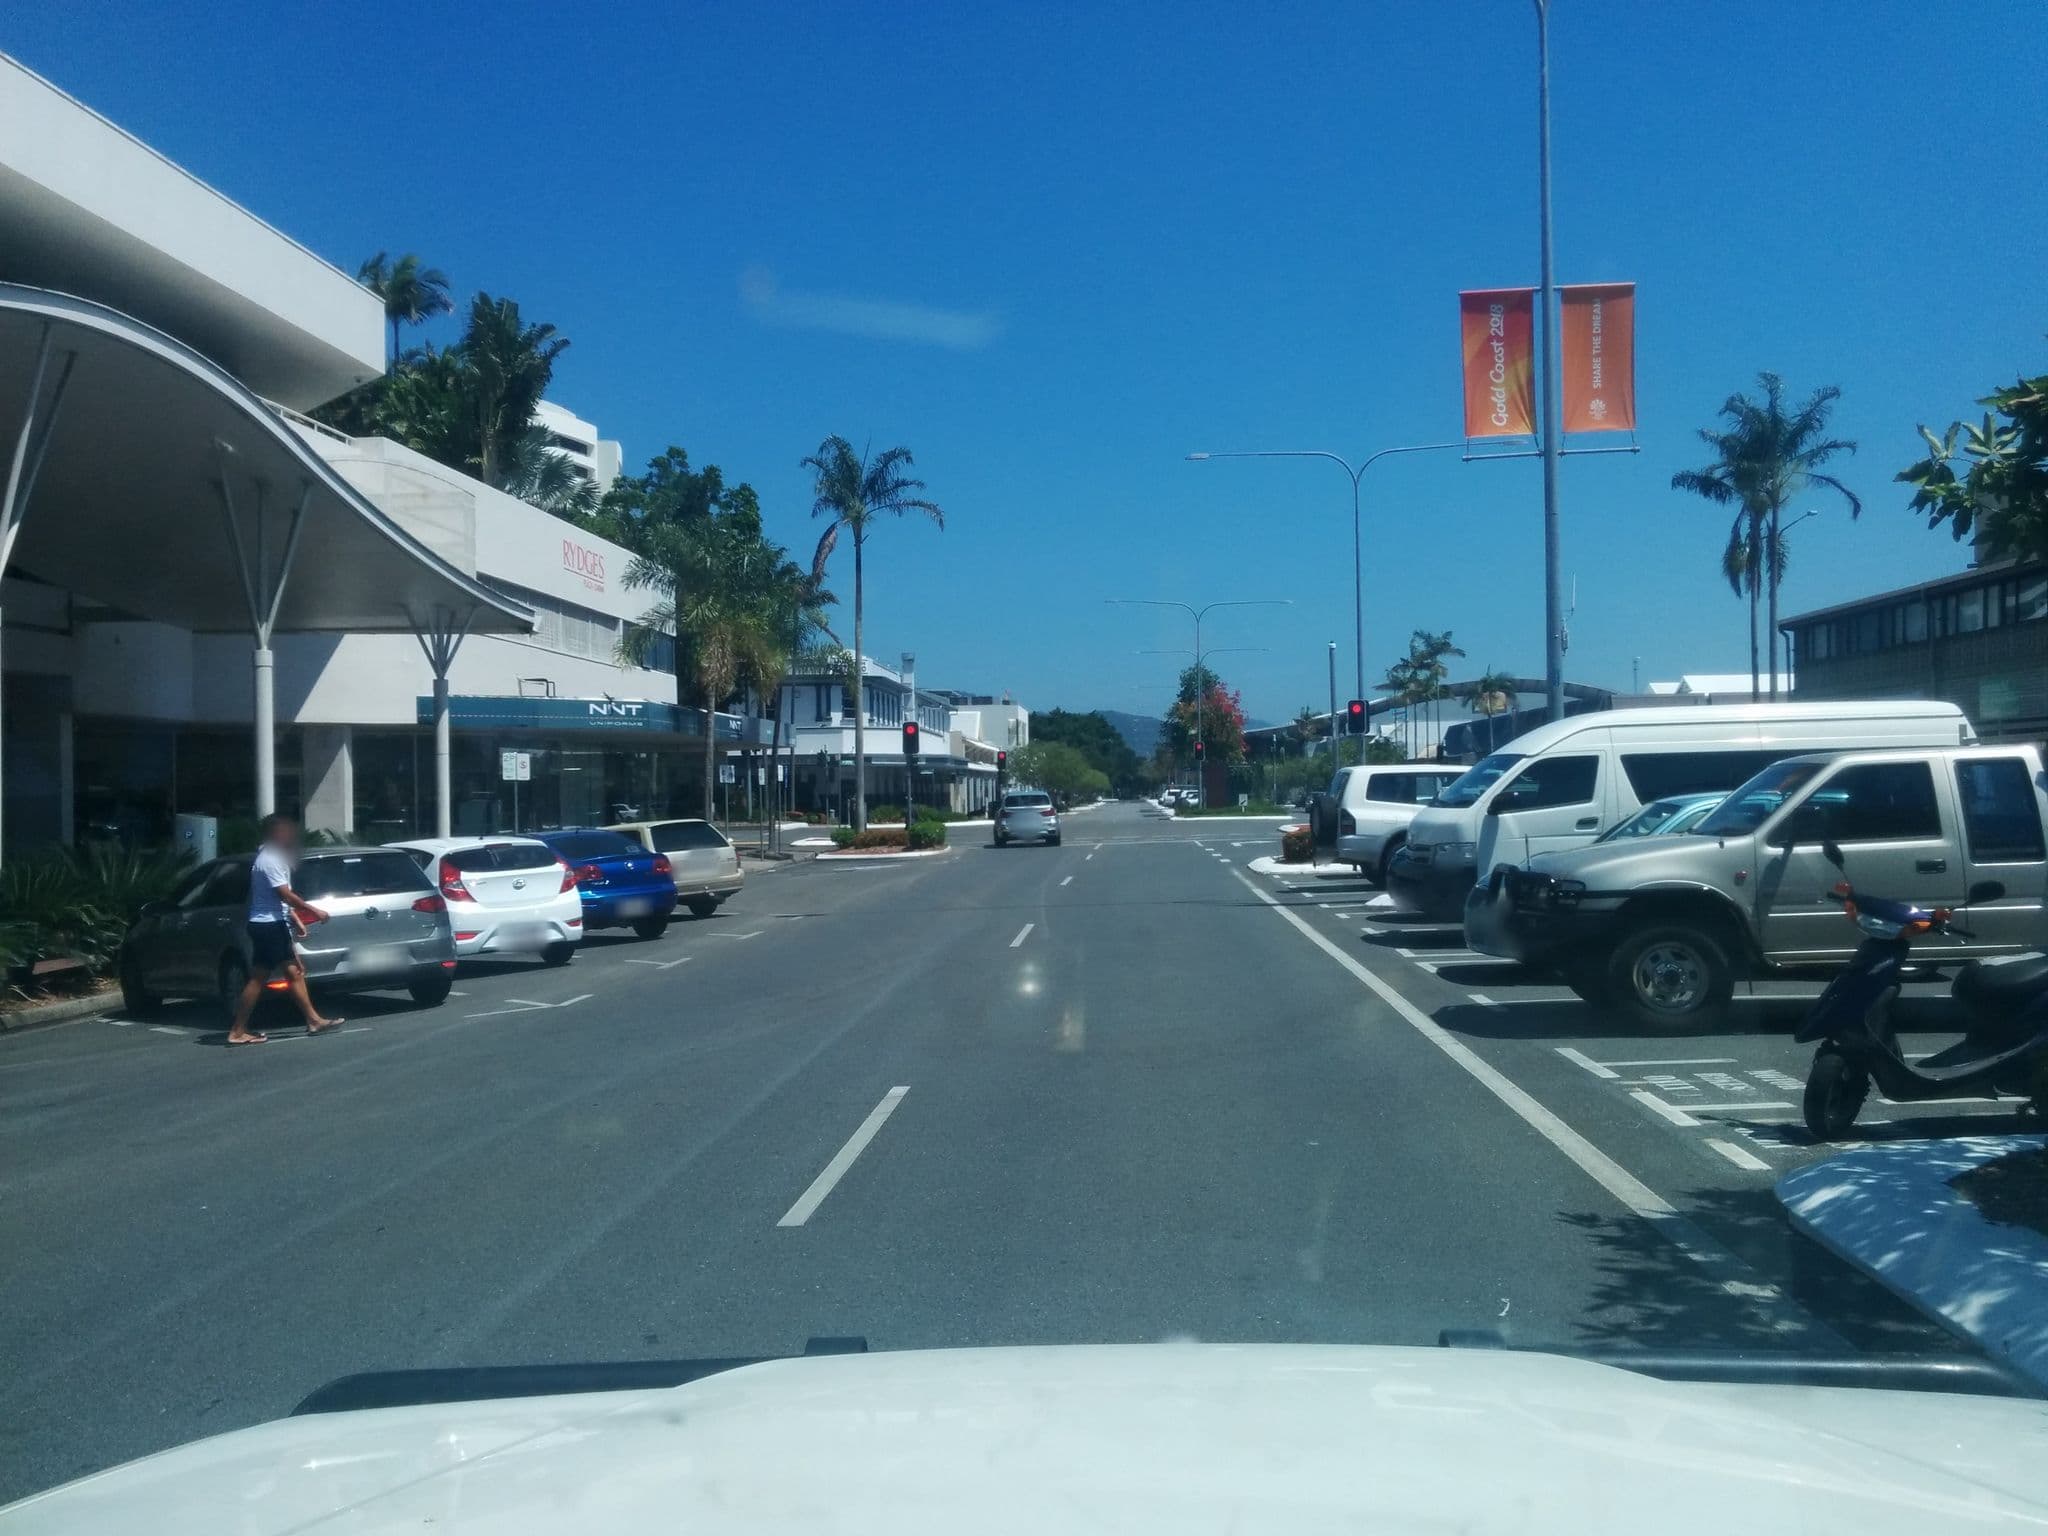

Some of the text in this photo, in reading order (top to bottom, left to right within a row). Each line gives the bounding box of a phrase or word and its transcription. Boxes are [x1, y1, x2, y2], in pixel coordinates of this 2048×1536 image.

[1592, 335, 1601, 355] THE
[1490, 303, 1508, 426] Gold Coast 2018
[1592, 357, 1601, 389] SHARE
[563, 539, 605, 579] RYDGES
[589, 702, 643, 715] NNT
